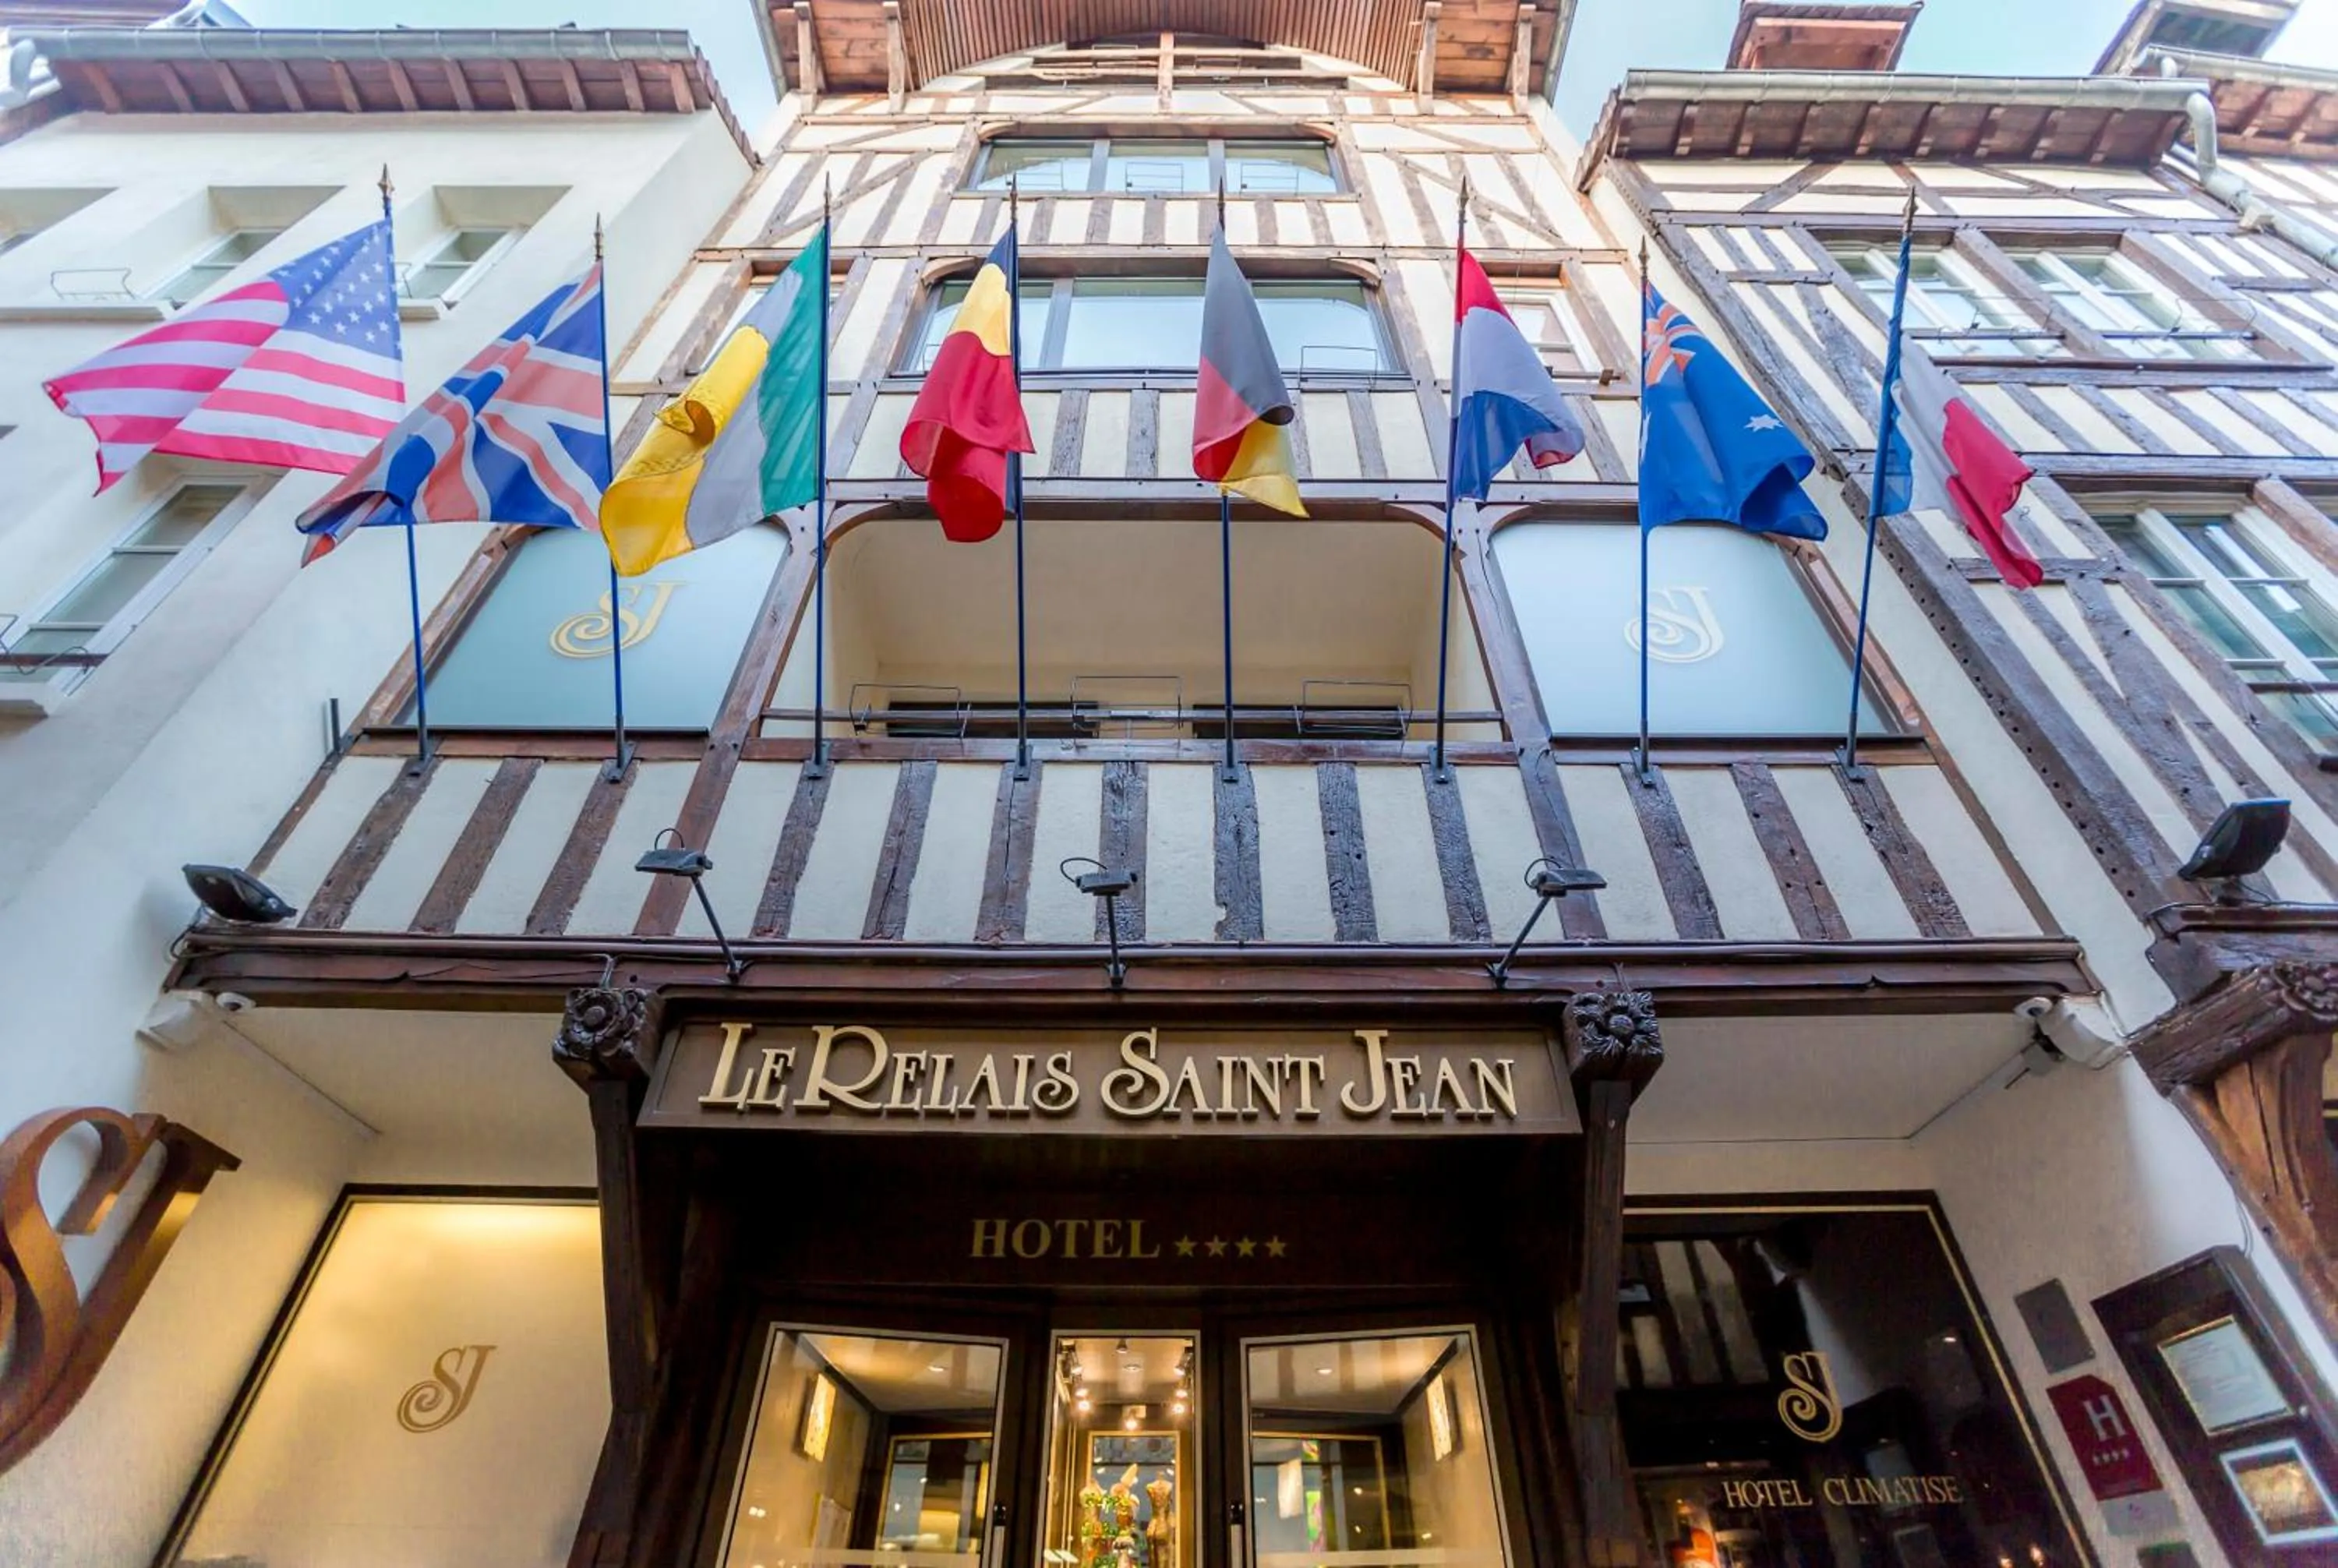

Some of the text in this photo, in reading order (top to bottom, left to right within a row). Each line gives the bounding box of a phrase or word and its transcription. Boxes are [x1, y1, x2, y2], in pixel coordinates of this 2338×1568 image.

[698, 1022, 1518, 1119] LE RELAIS SAINT JEAN
[969, 1218, 1161, 1259] HOTEL
[2082, 1394, 2128, 1443] H
[1722, 1475, 1965, 1509] HOTEL CLIMATISE
